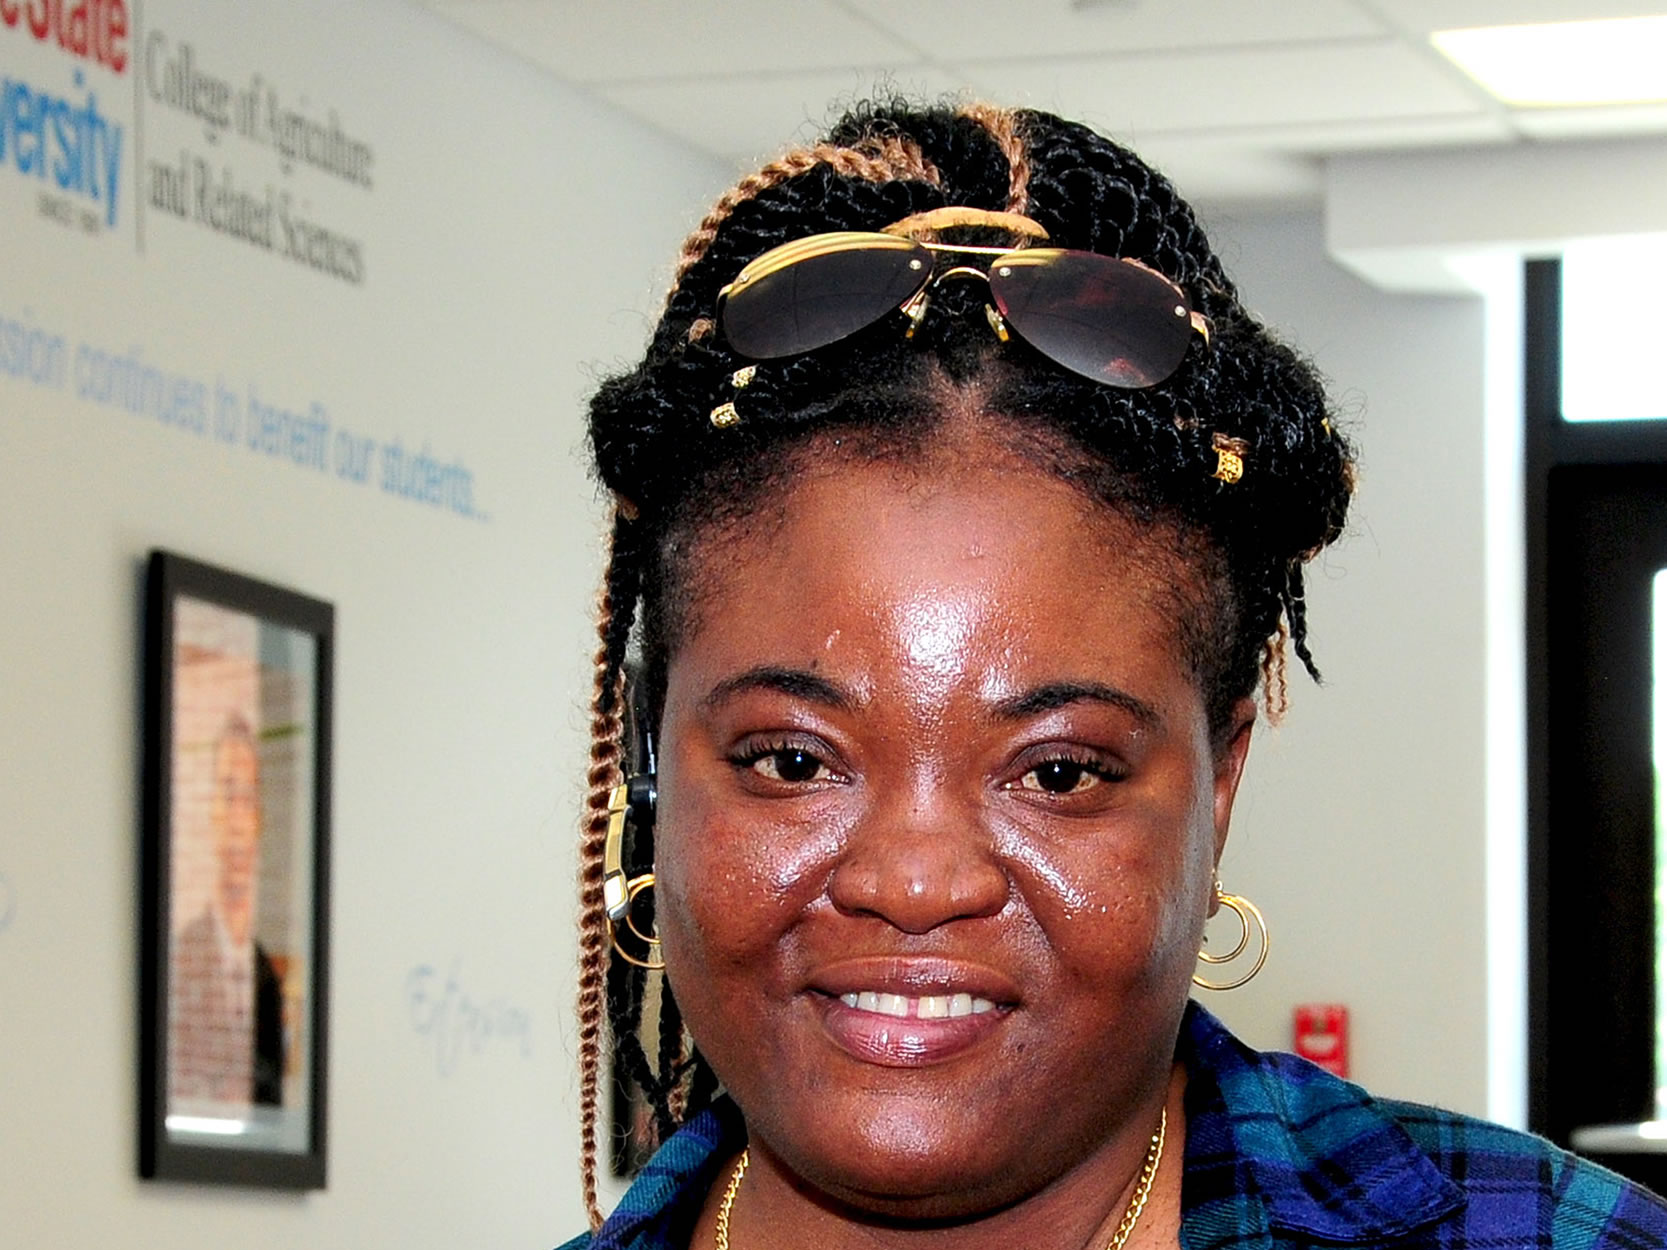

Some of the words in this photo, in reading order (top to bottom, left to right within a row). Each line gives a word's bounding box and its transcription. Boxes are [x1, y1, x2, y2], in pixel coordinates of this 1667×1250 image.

[145, 28, 232, 147] College
[236, 72, 264, 139] of
[259, 84, 375, 192] Agriculture
[148, 150, 188, 220] and
[193, 156, 274, 250] Related
[275, 190, 366, 285] Sciences
[75, 343, 206, 433] continues
[213, 376, 239, 444] to
[247, 382, 328, 471] benefit
[334, 428, 375, 484] our
